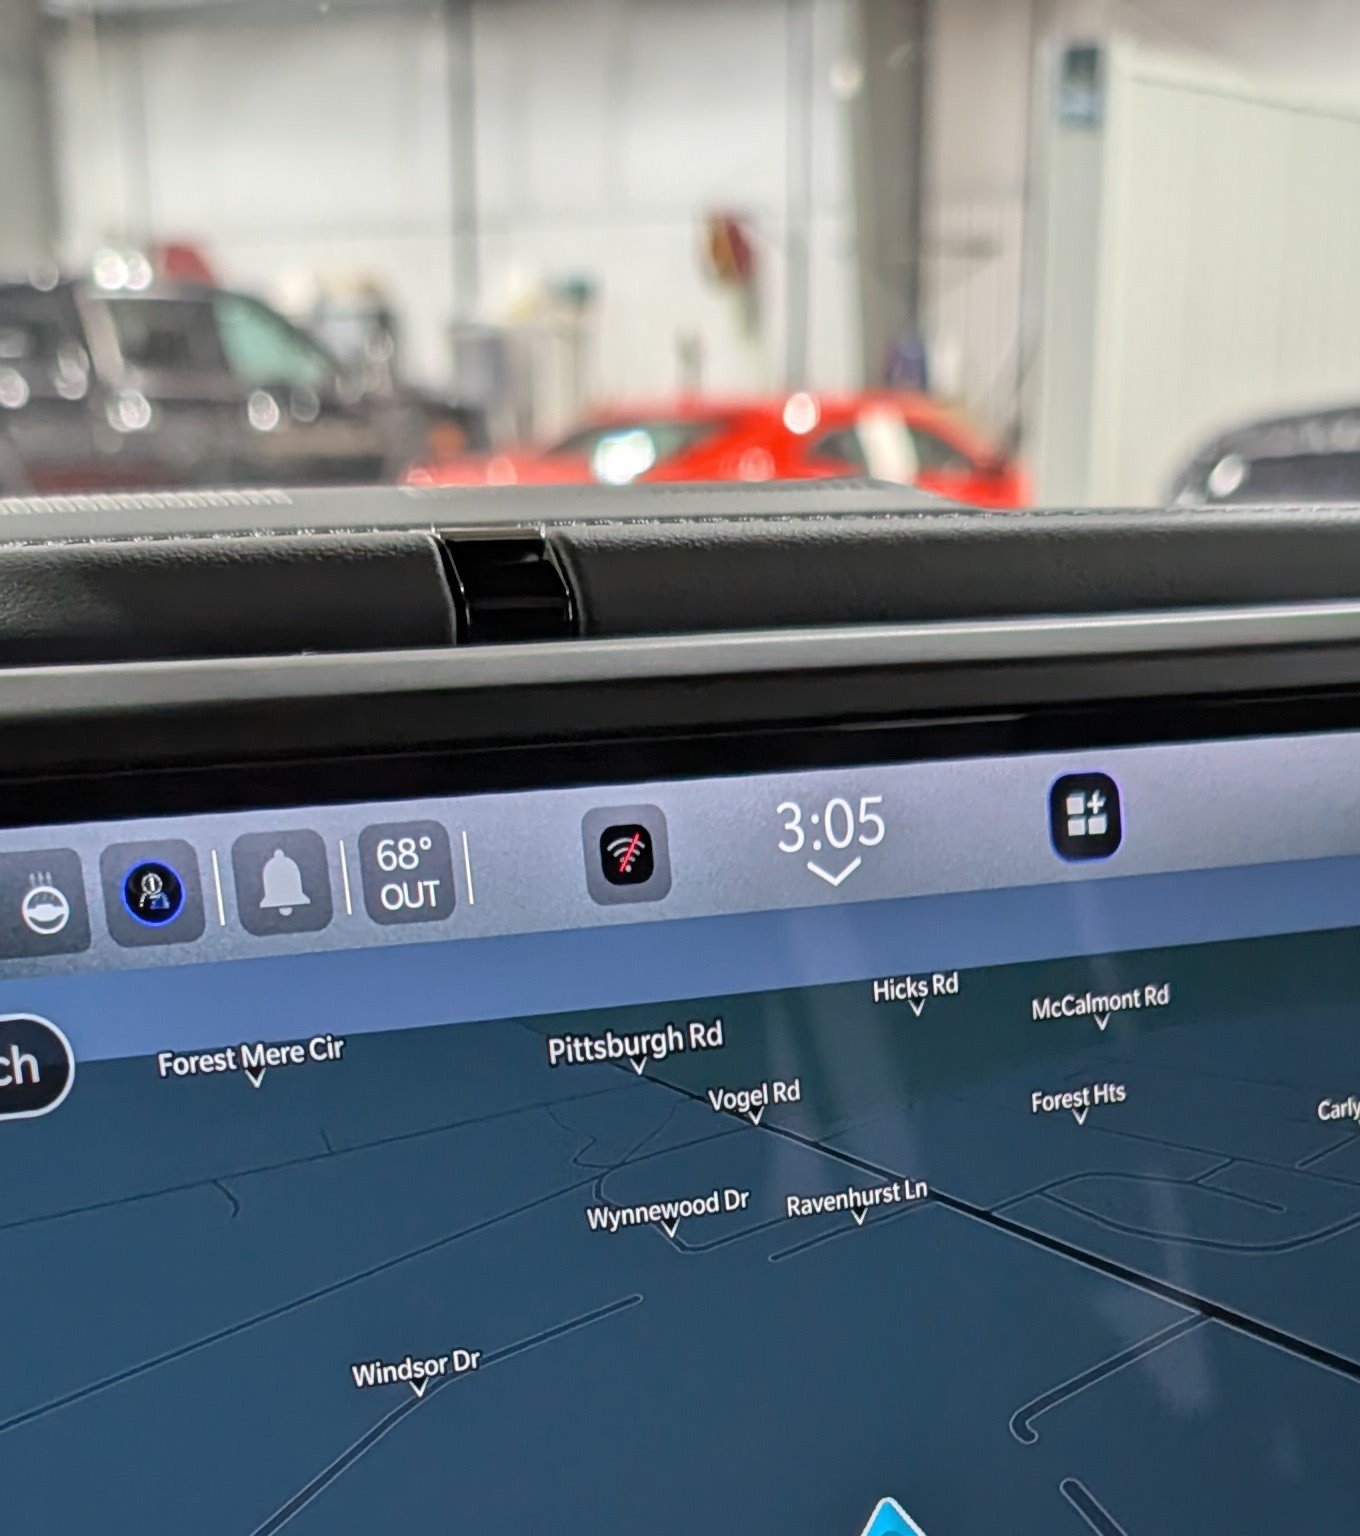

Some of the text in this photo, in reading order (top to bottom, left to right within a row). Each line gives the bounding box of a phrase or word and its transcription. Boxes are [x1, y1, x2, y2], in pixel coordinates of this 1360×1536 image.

[776, 796, 886, 853] 3:05
[376, 836, 432, 872] 68°
[381, 879, 441, 911] OUT
[872, 971, 959, 1003] Hicks Rd
[1031, 982, 1170, 1020] McCalmont Rd
[158, 1035, 344, 1077] Forest Mere Cir
[548, 1021, 724, 1065] Pittsburgh Rd
[708, 1079, 801, 1112] Vogel Rd
[1031, 1083, 1126, 1112] Forest Hts
[587, 1189, 749, 1231] Wynnewood Dr
[786, 1179, 928, 1217] Ravenhurst Ln
[352, 1350, 481, 1387] Windsor Dr
